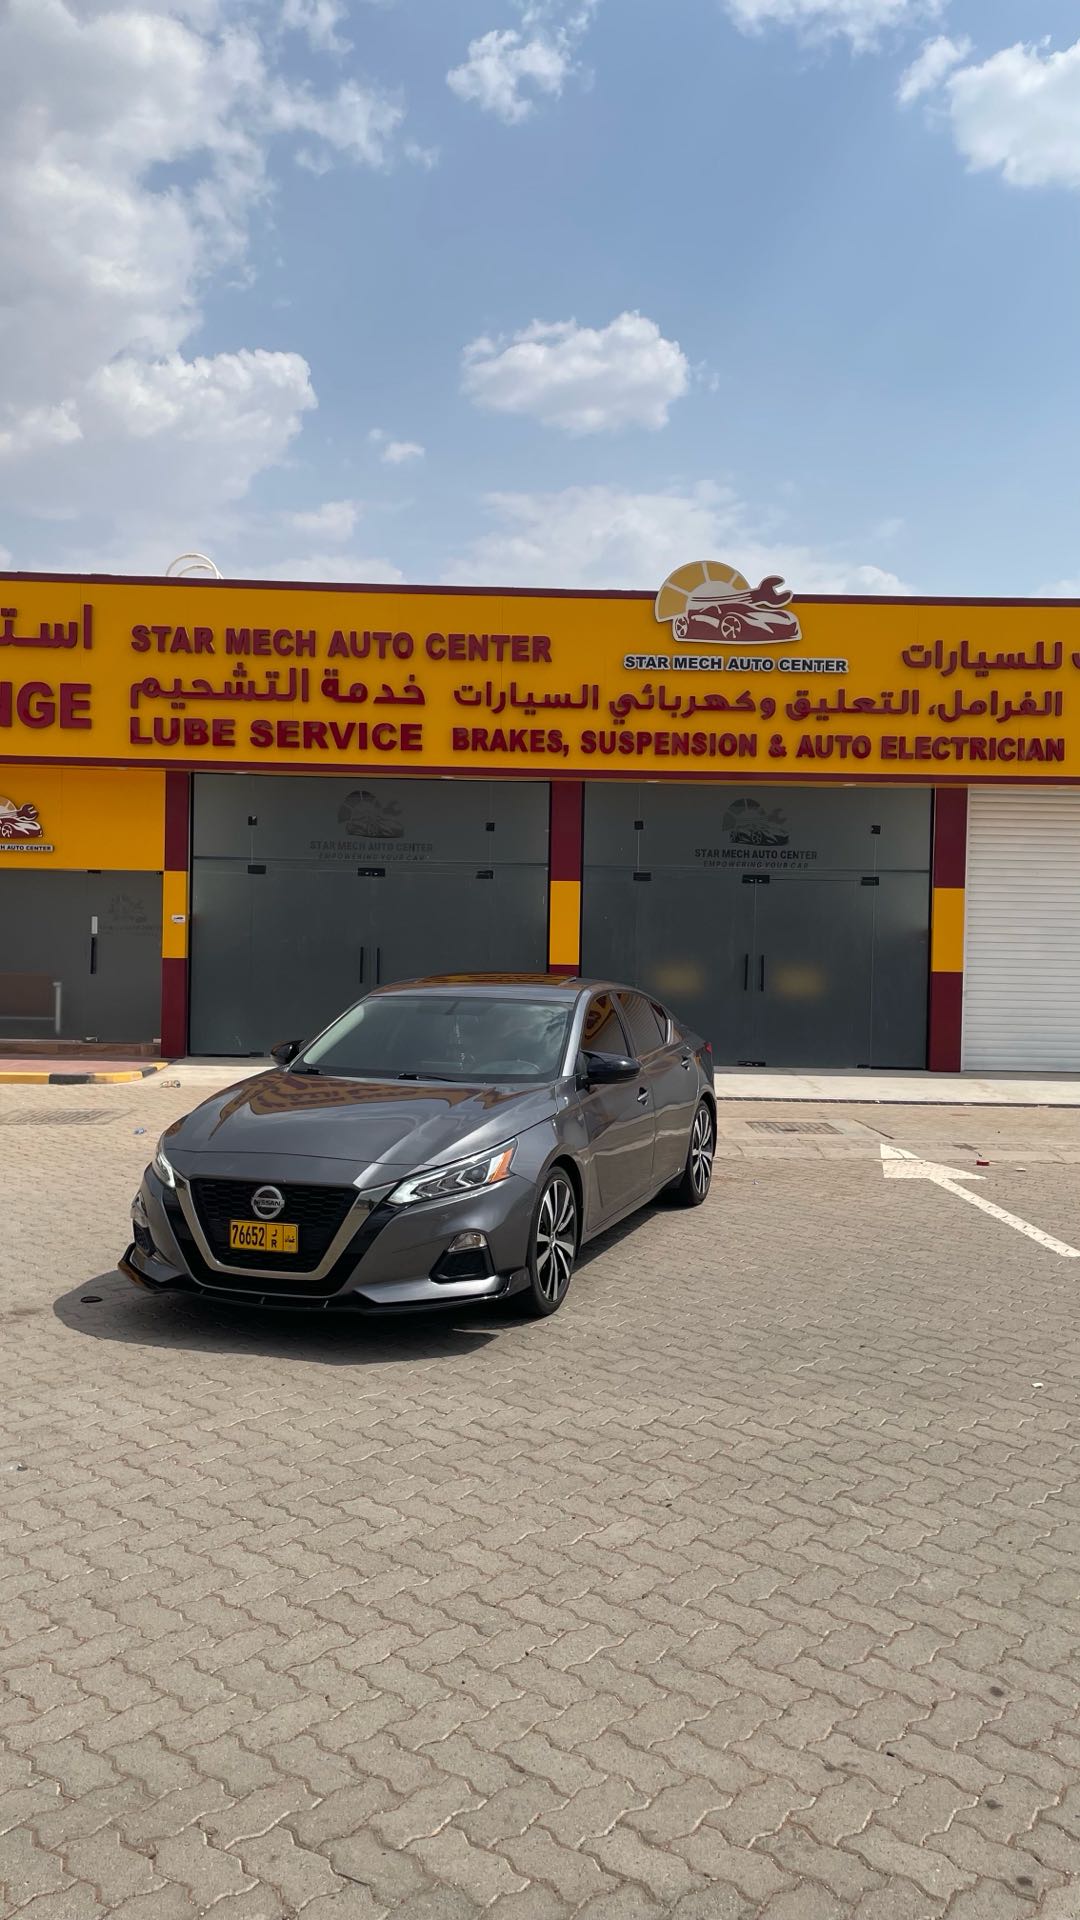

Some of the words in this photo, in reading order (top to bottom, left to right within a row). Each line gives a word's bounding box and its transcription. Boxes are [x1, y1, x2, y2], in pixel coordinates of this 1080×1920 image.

[131, 625, 215, 655] STAR
[226, 628, 316, 657] MECH
[328, 631, 415, 660] AUTO
[426, 633, 552, 663] CENTER
[902, 640, 1062, 677] للسيارات
[625, 656, 669, 669] STAR
[674, 657, 722, 670] MECH
[727, 658, 774, 671] AUTO
[779, 659, 848, 673] CENTER
[130, 662, 309, 710] التشحيم
[321, 669, 425, 705] خدمة
[454, 681, 599, 715] السيارات
[609, 684, 776, 725] وكهربائي
[786, 689, 919, 721] التعليق
[130, 717, 236, 747] LUBE
[250, 720, 422, 752] SERVICE
[453, 728, 569, 757] BRAKES,
[581, 730, 757, 757] SUSPENSION
[768, 734, 787, 758] &
[796, 735, 872, 759] AUTO
[881, 736, 1065, 762] ELECTRICIAN
[310, 841, 336, 850] STAR
[338, 841, 366, 851] MECH
[368, 842, 394, 851] AUTO
[396, 843, 433, 852] CENTER
[694, 848, 720, 858] STAR
[721, 849, 750, 859] MECH
[751, 849, 778, 859] AUTO
[780, 850, 817, 860] CENTER
[703, 860, 762, 868] EMPOWERING
[764, 861, 788, 869] YOUR
[232, 1224, 265, 1247] 76652
[271, 1239, 277, 1248] R
